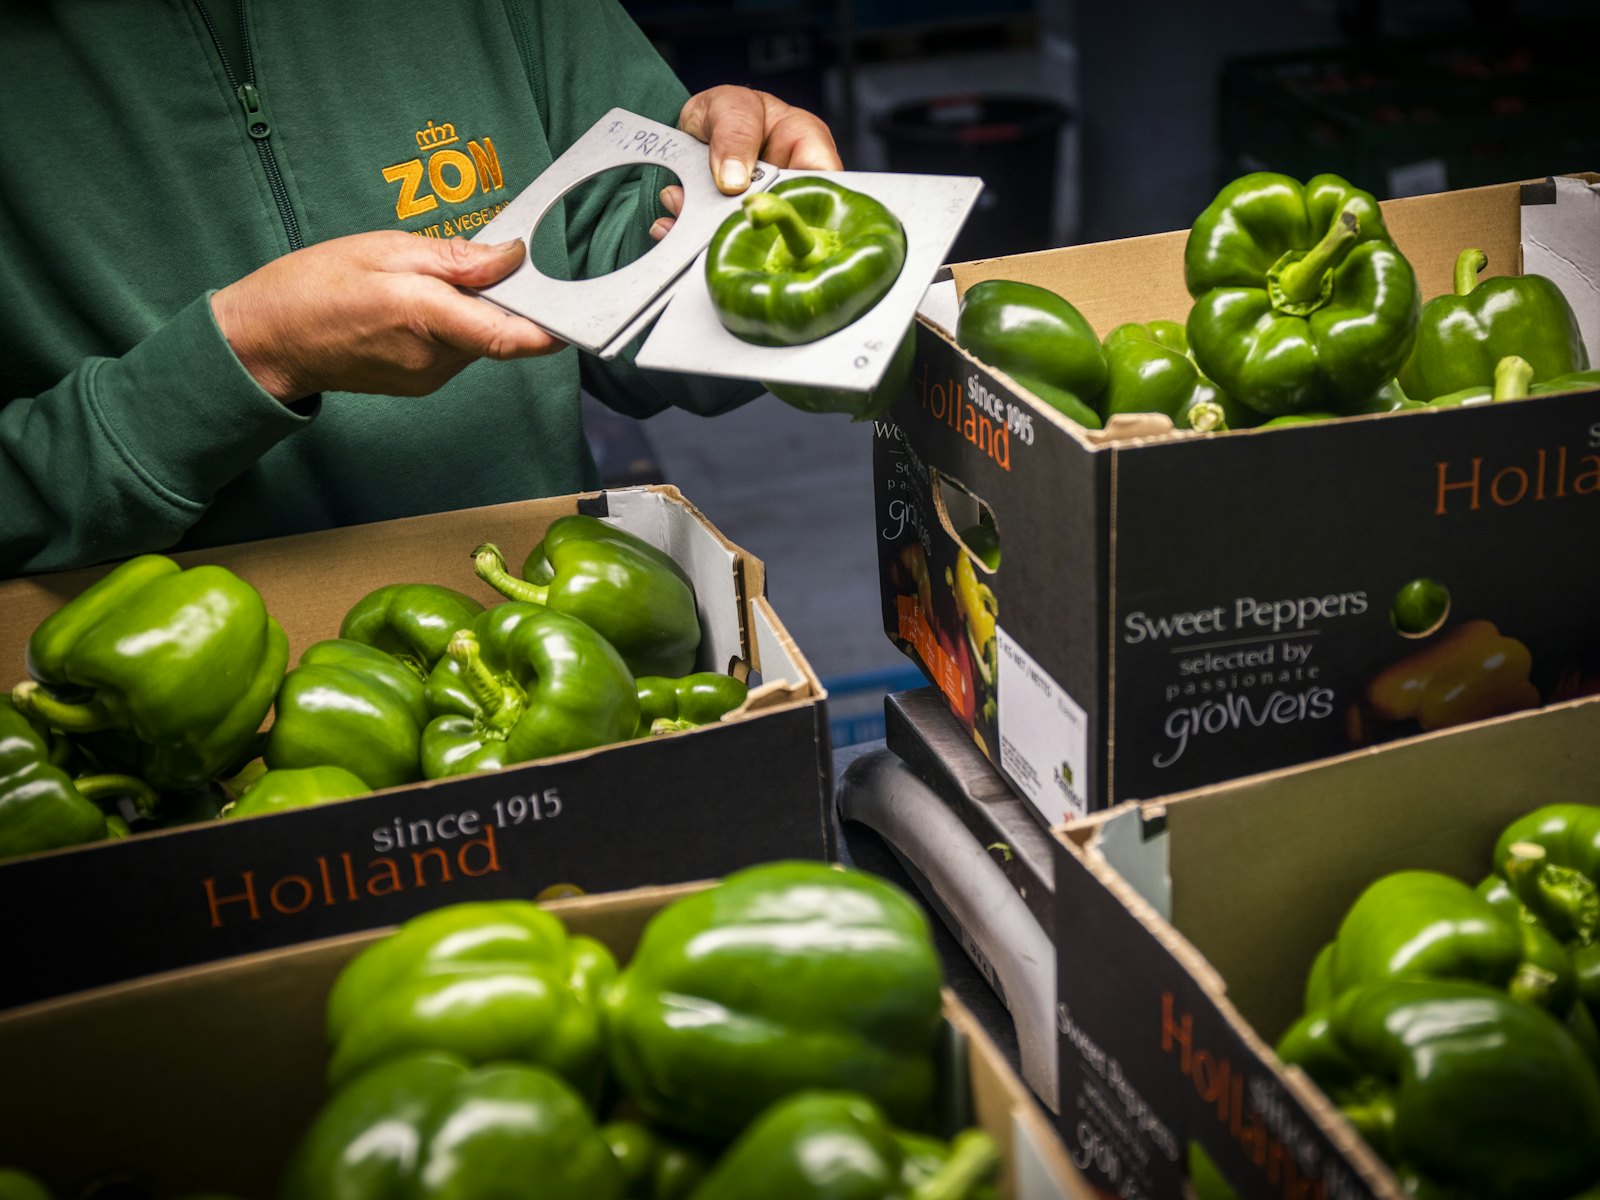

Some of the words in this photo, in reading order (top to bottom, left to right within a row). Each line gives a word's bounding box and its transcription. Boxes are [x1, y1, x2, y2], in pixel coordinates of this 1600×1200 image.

[382, 137, 504, 220] ZON
[443, 220, 456, 236] &
[967, 373, 1005, 423] since
[1006, 402, 1034, 446] 1915
[1435, 446, 1600, 515] Holla
[1124, 606, 1227, 644] Sweet
[1235, 590, 1369, 632] Peppers
[1165, 665, 1321, 701] passionate
[1178, 643, 1275, 676] selected
[1282, 641, 1313, 664] by
[1152, 686, 1336, 769] growers
[372, 808, 481, 853] since
[493, 788, 563, 829] 1915
[203, 824, 502, 928] Holland
